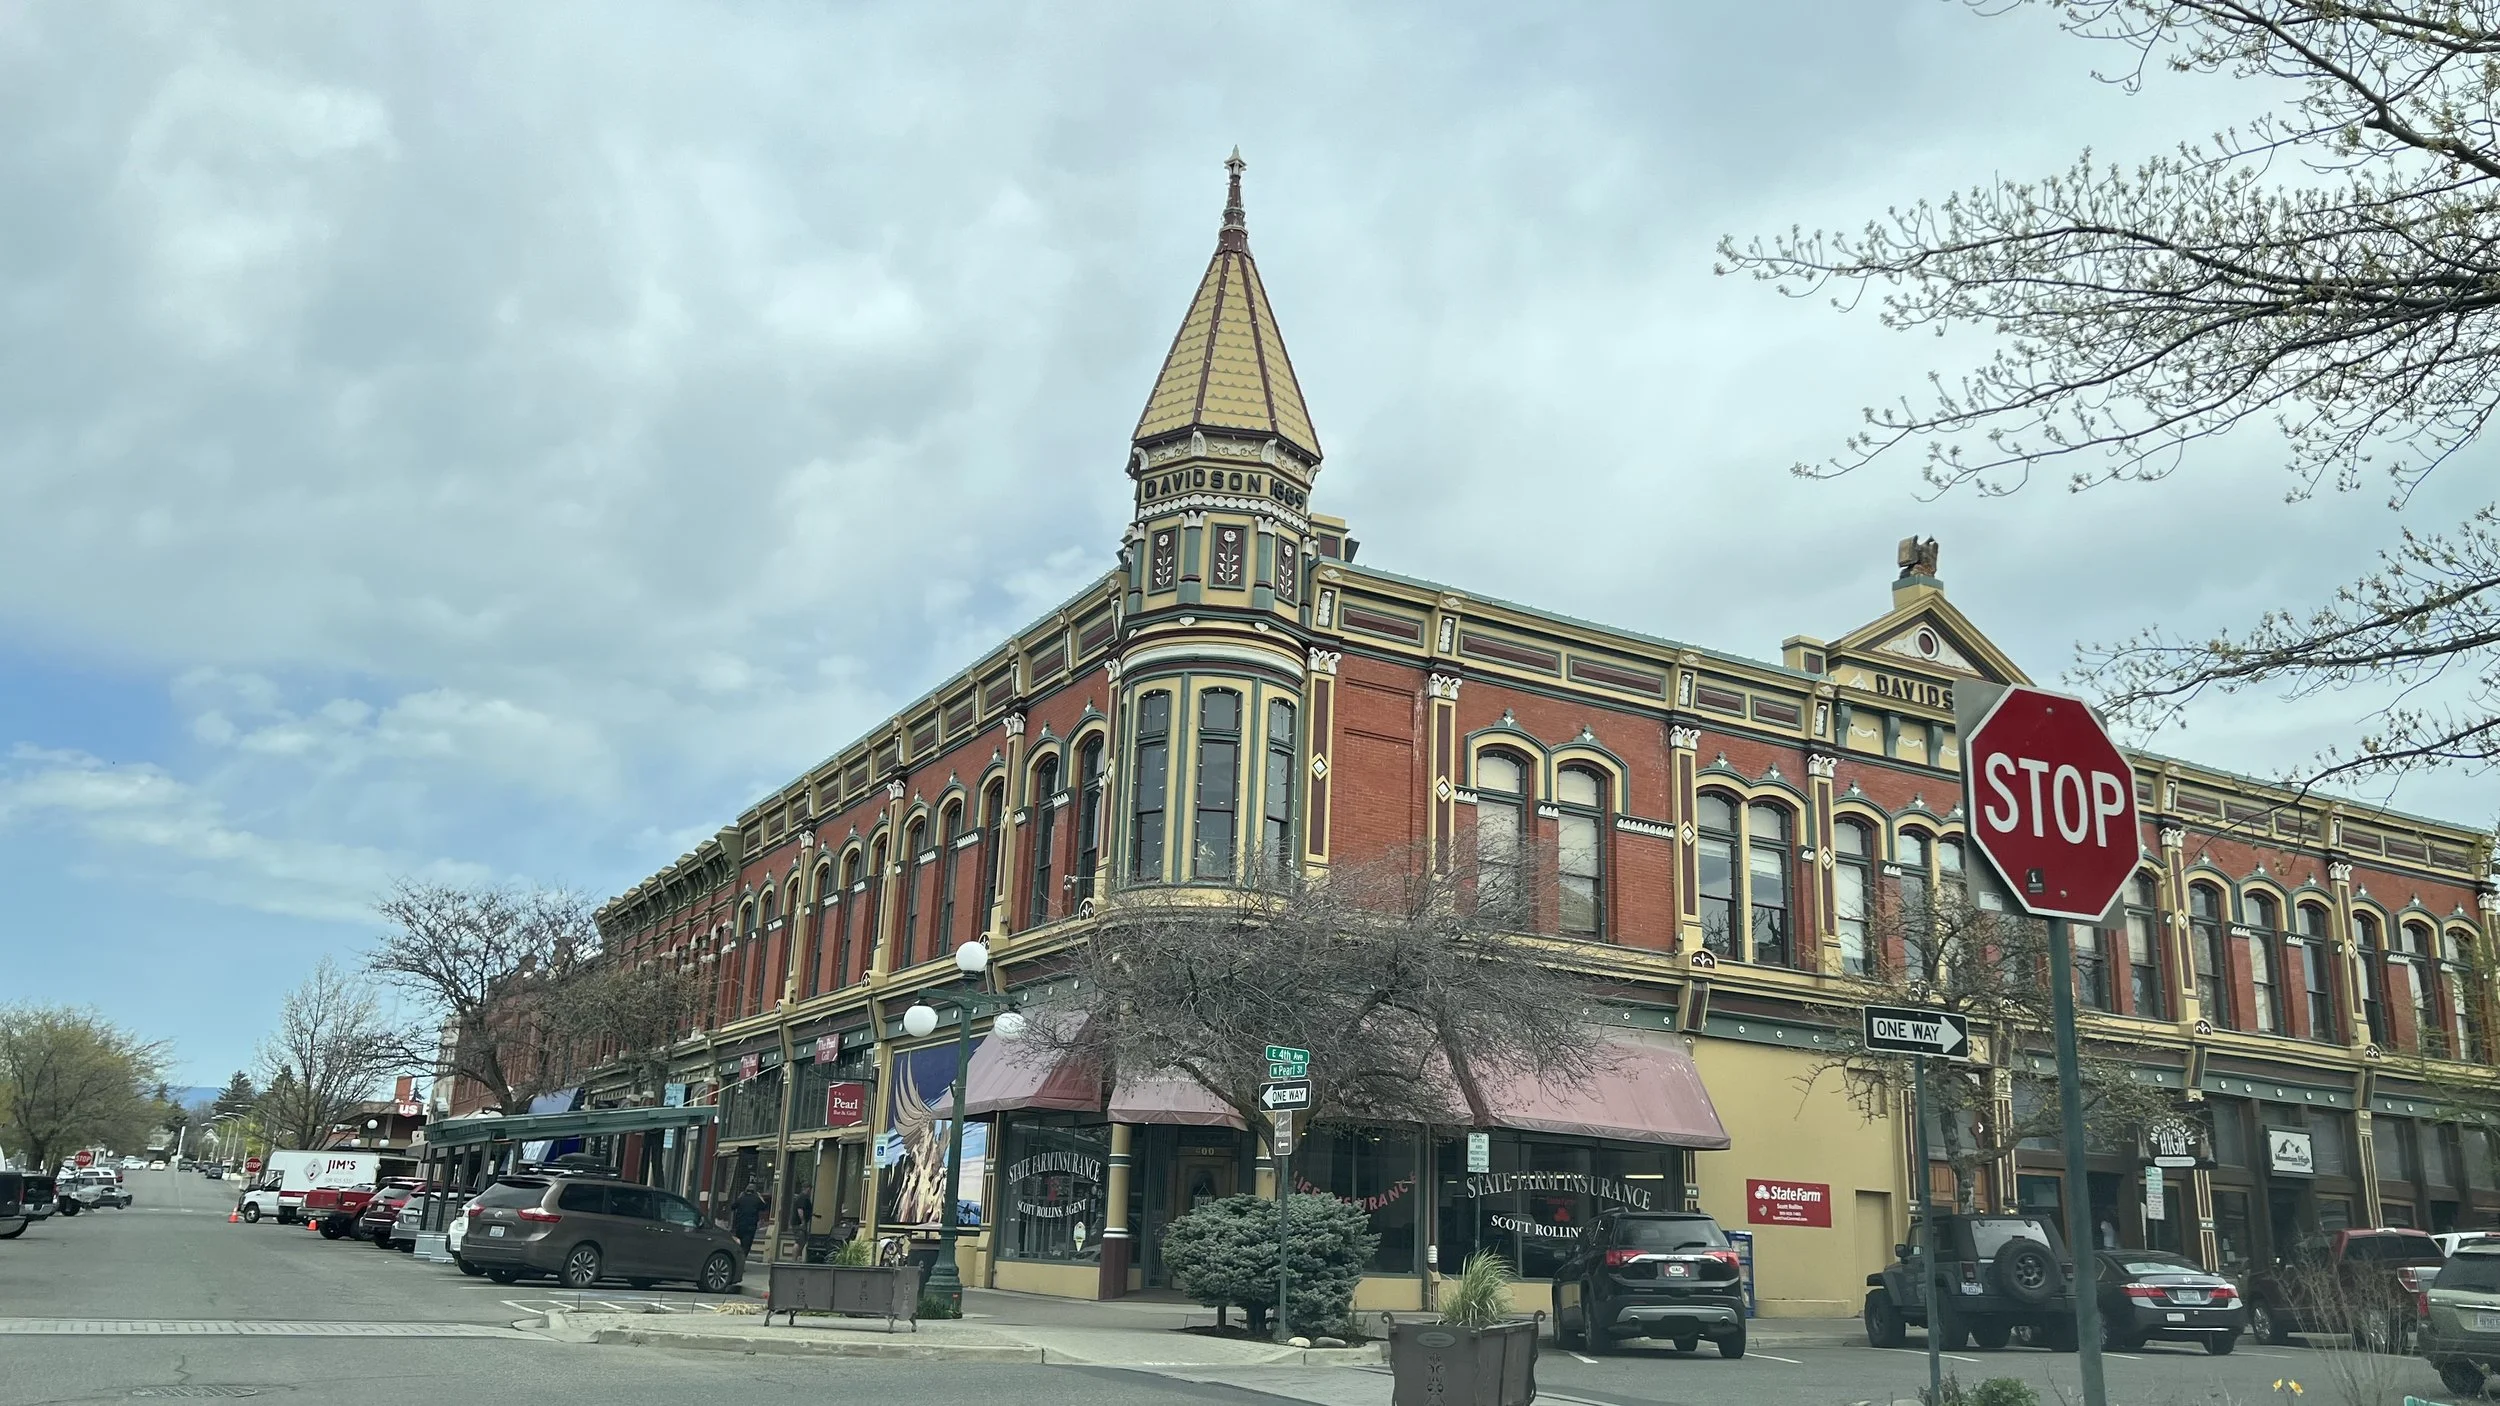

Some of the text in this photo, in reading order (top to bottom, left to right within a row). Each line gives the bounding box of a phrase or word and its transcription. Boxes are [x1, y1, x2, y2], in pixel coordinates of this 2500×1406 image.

[1144, 468, 1306, 510] DAVIDSON 1889
[1984, 751, 2126, 848] STOP
[1877, 1020, 1940, 1041] ONE WAY
[1272, 1049, 1304, 1061] E 4th Ave
[1273, 1065, 1303, 1076] N Pearl St
[833, 1097, 858, 1110] Pearl
[1272, 1089, 1305, 1102] ONE WAY
[2159, 1128, 2187, 1155] HIGH
[75, 1155, 92, 1163] STOP
[326, 1159, 357, 1174] JIM'S
[1009, 1151, 1101, 1185] STATE FARM INSURANCE
[1466, 1170, 1652, 1211] STATE FARM INSURANCE
[1017, 1200, 1036, 1216] SCOTT
[1064, 1198, 1087, 1216] AGENT
[1491, 1214, 1531, 1234] SCOTT
